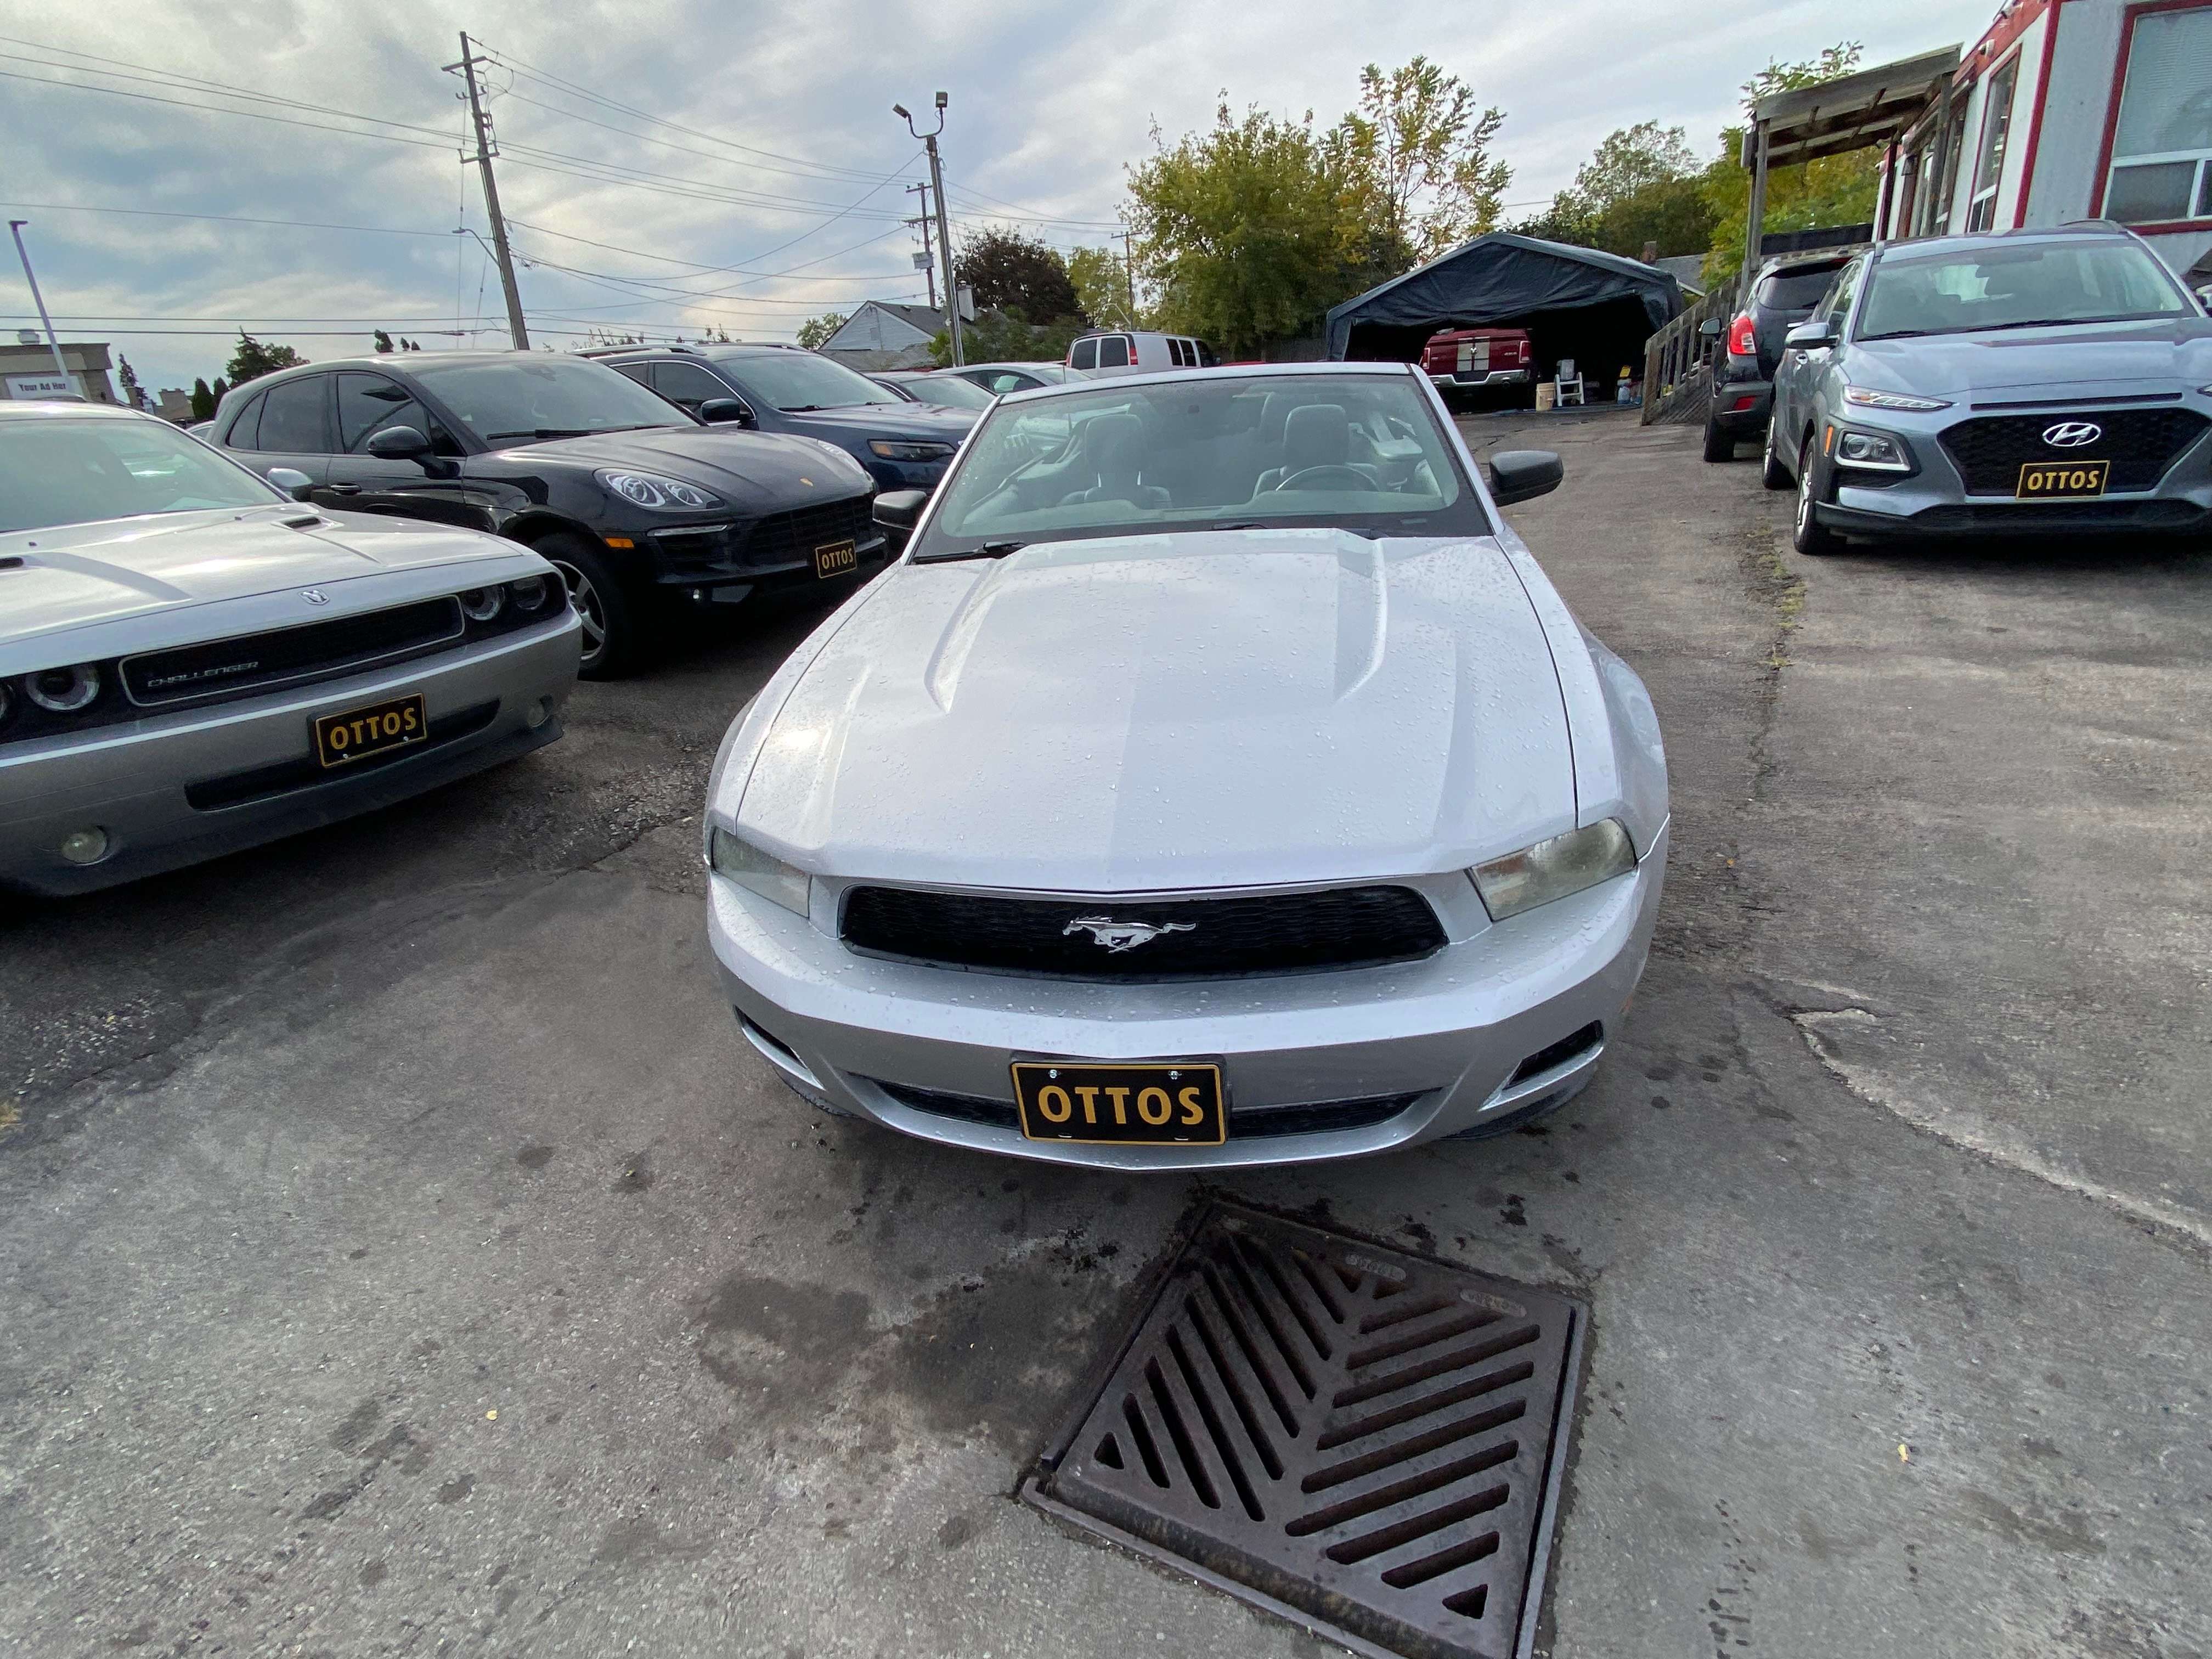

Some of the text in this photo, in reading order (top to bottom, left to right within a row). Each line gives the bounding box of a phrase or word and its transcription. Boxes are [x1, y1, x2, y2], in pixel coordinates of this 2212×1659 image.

[2027, 471, 2100, 490] OTTOS
[822, 548, 853, 569] OTTOS
[148, 661, 258, 687] CHALLENGER
[330, 707, 416, 750] OTTOS
[1038, 1085, 1204, 1125] OTTOS
